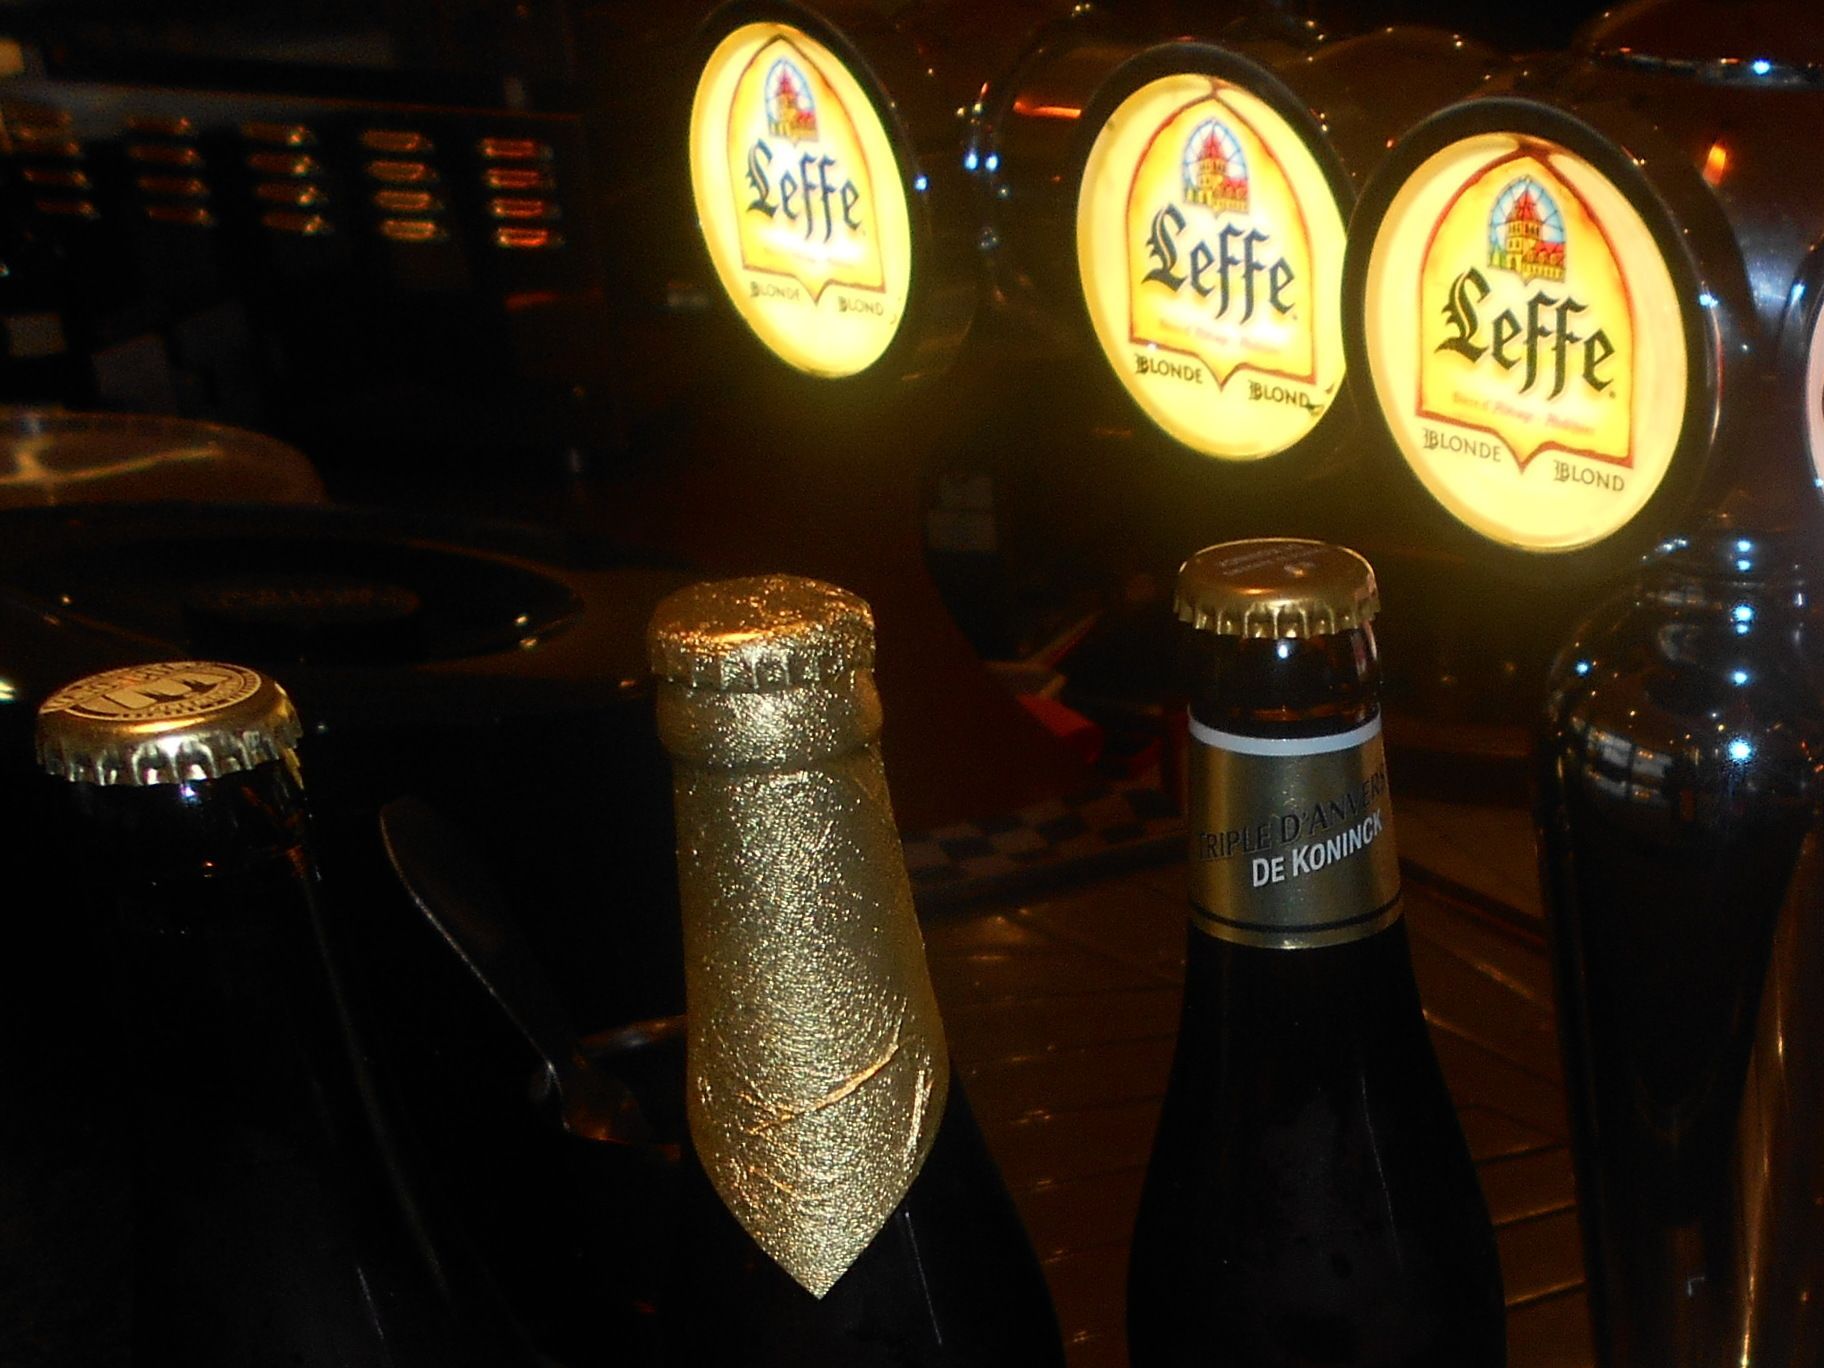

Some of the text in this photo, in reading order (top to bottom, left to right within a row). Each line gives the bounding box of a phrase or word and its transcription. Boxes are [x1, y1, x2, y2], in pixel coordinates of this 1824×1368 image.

[746, 138, 862, 242] Leffe
[1142, 202, 1296, 324] Leffe
[1433, 266, 1614, 400] Leffe
[1135, 352, 1203, 385] BLONDE
[1248, 379, 1311, 409] BLOND
[1422, 427, 1502, 464] BLONDE
[1554, 459, 1627, 493] BLOND
[1252, 808, 1383, 888] DE KONINCK
